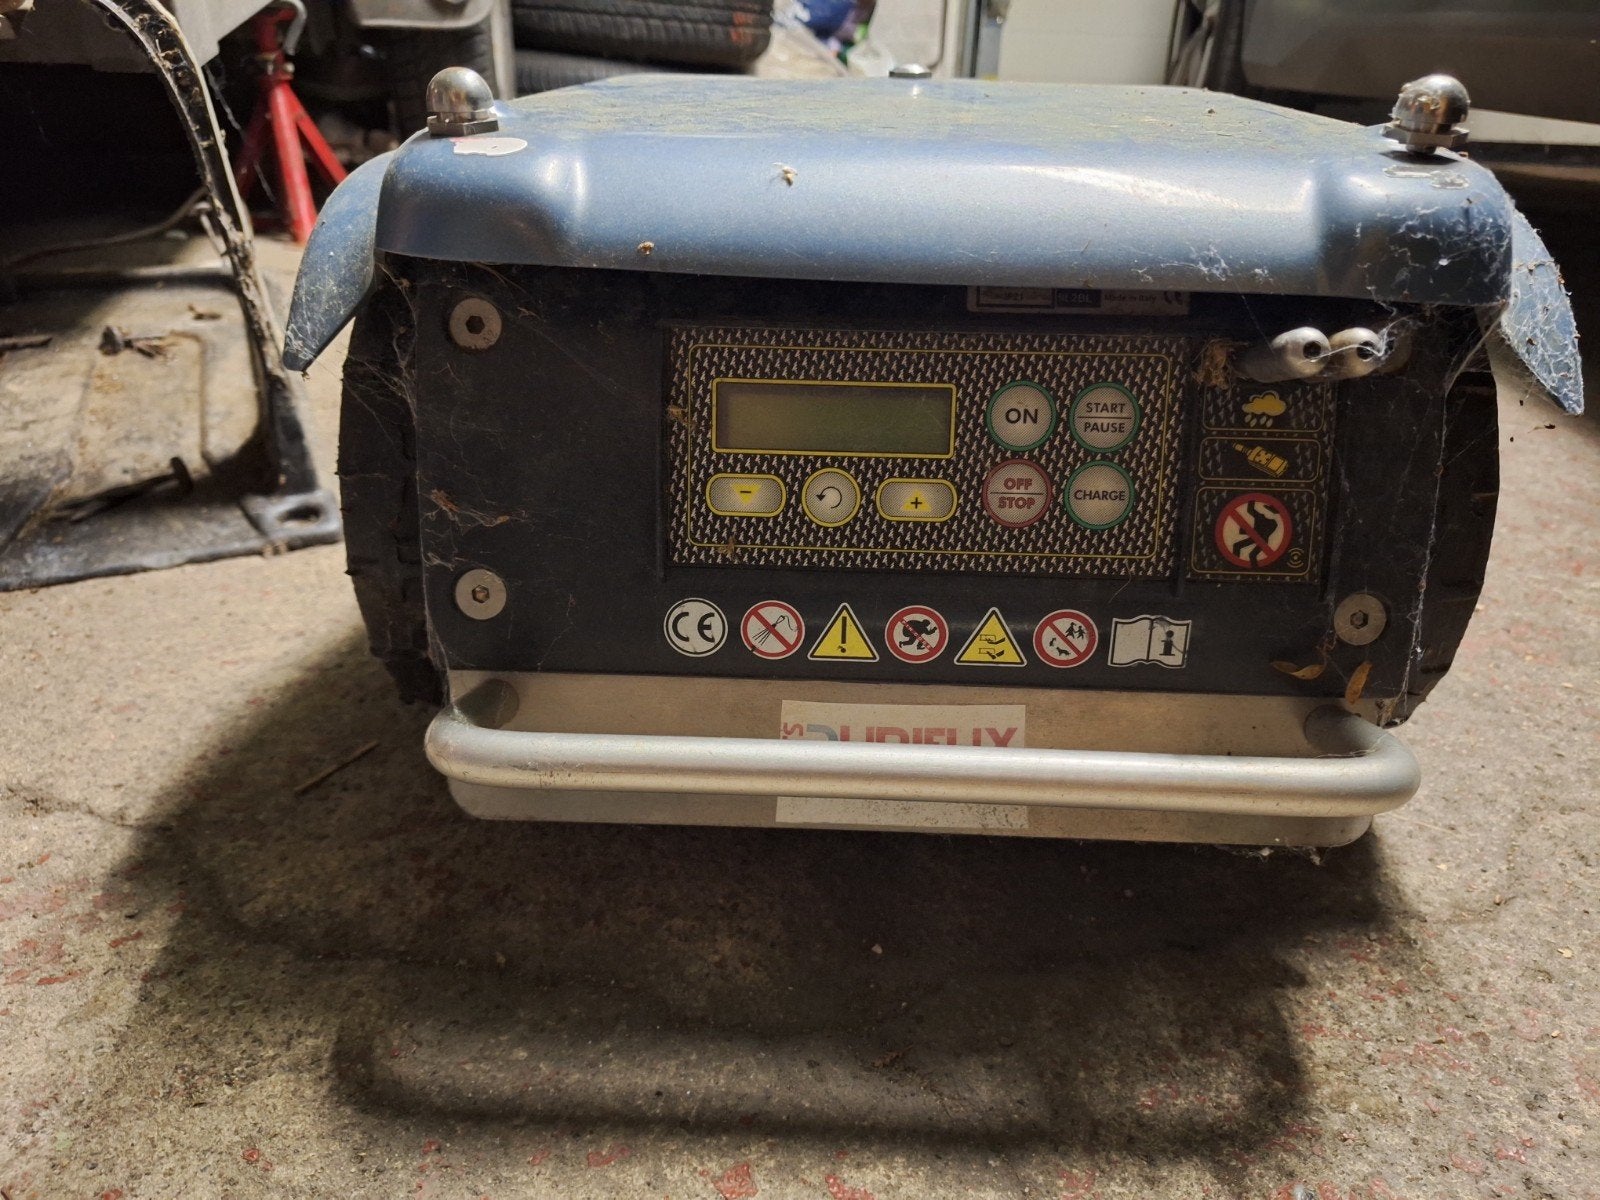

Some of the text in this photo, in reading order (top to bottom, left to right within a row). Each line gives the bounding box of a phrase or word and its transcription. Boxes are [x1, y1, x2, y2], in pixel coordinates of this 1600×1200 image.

[1085, 402, 1126, 414] START
[1005, 407, 1039, 424] ON
[1084, 422, 1126, 433] PAUSE
[1003, 477, 1033, 491] OFF
[1074, 490, 1126, 501] CHARGE
[998, 496, 1036, 509] STOP
[671, 611, 715, 643] CE
